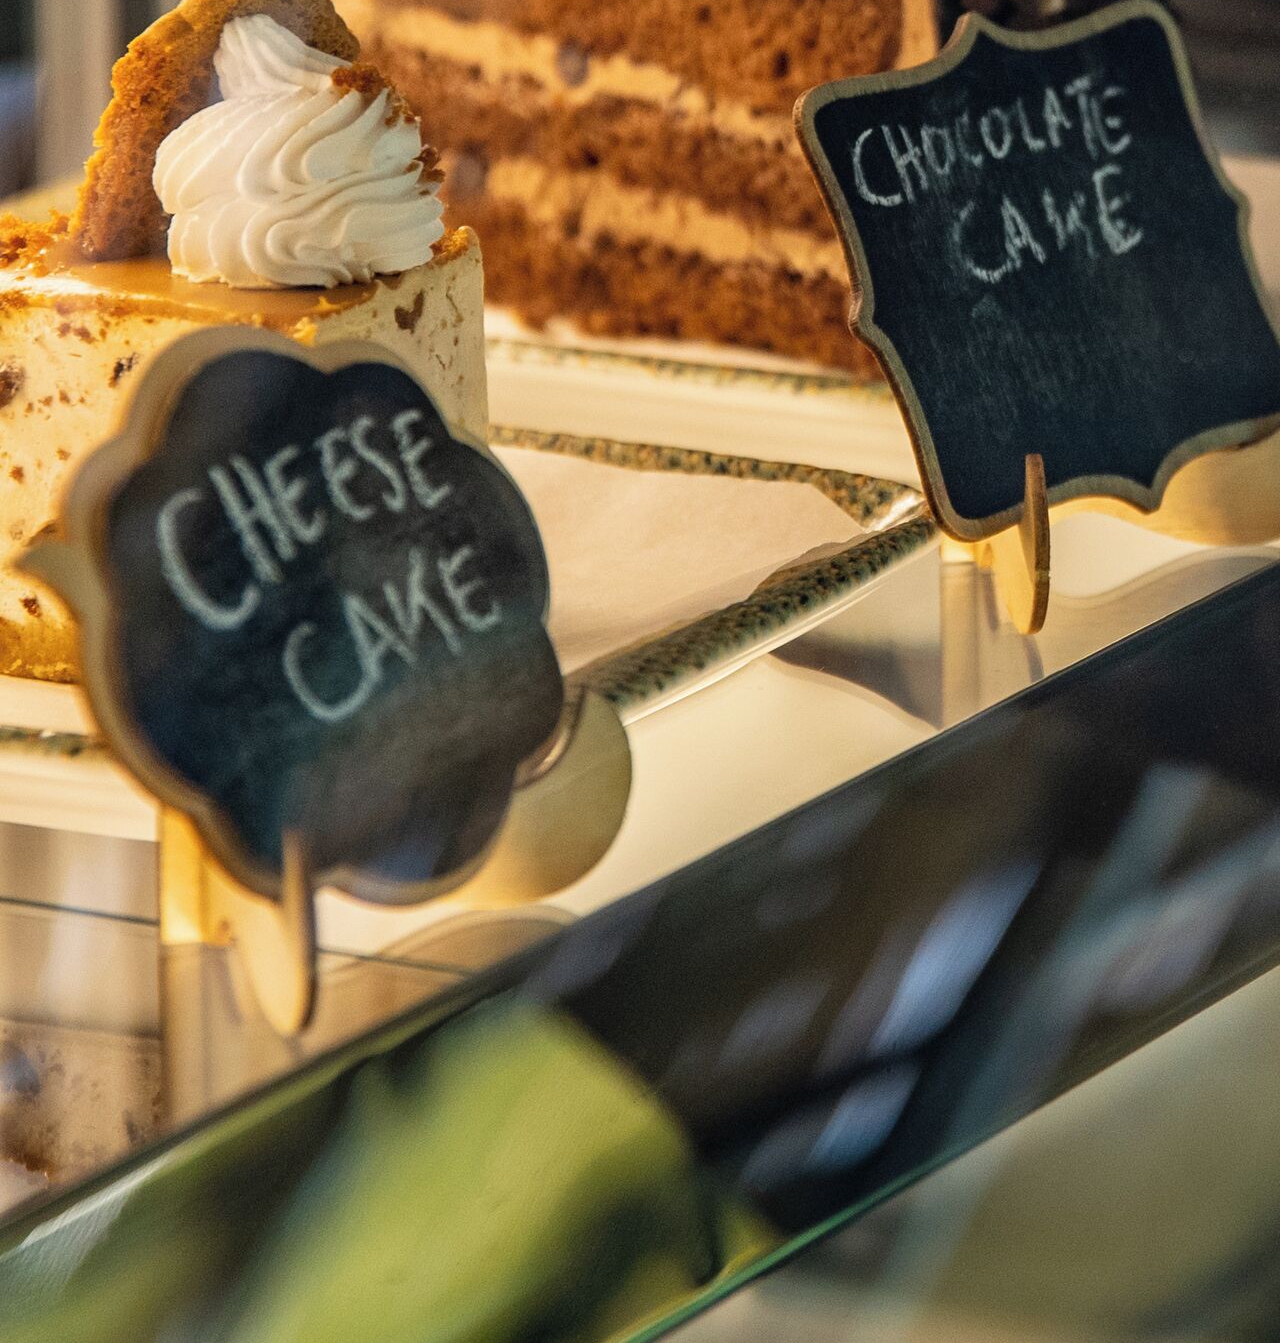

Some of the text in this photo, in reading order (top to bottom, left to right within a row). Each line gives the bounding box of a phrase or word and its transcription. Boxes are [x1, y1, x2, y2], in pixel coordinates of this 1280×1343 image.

[852, 75, 1132, 207] CHOCOLATE
[952, 165, 1144, 283] CAKE
[156, 409, 450, 630] CHEESE
[282, 546, 501, 721] CAKE
